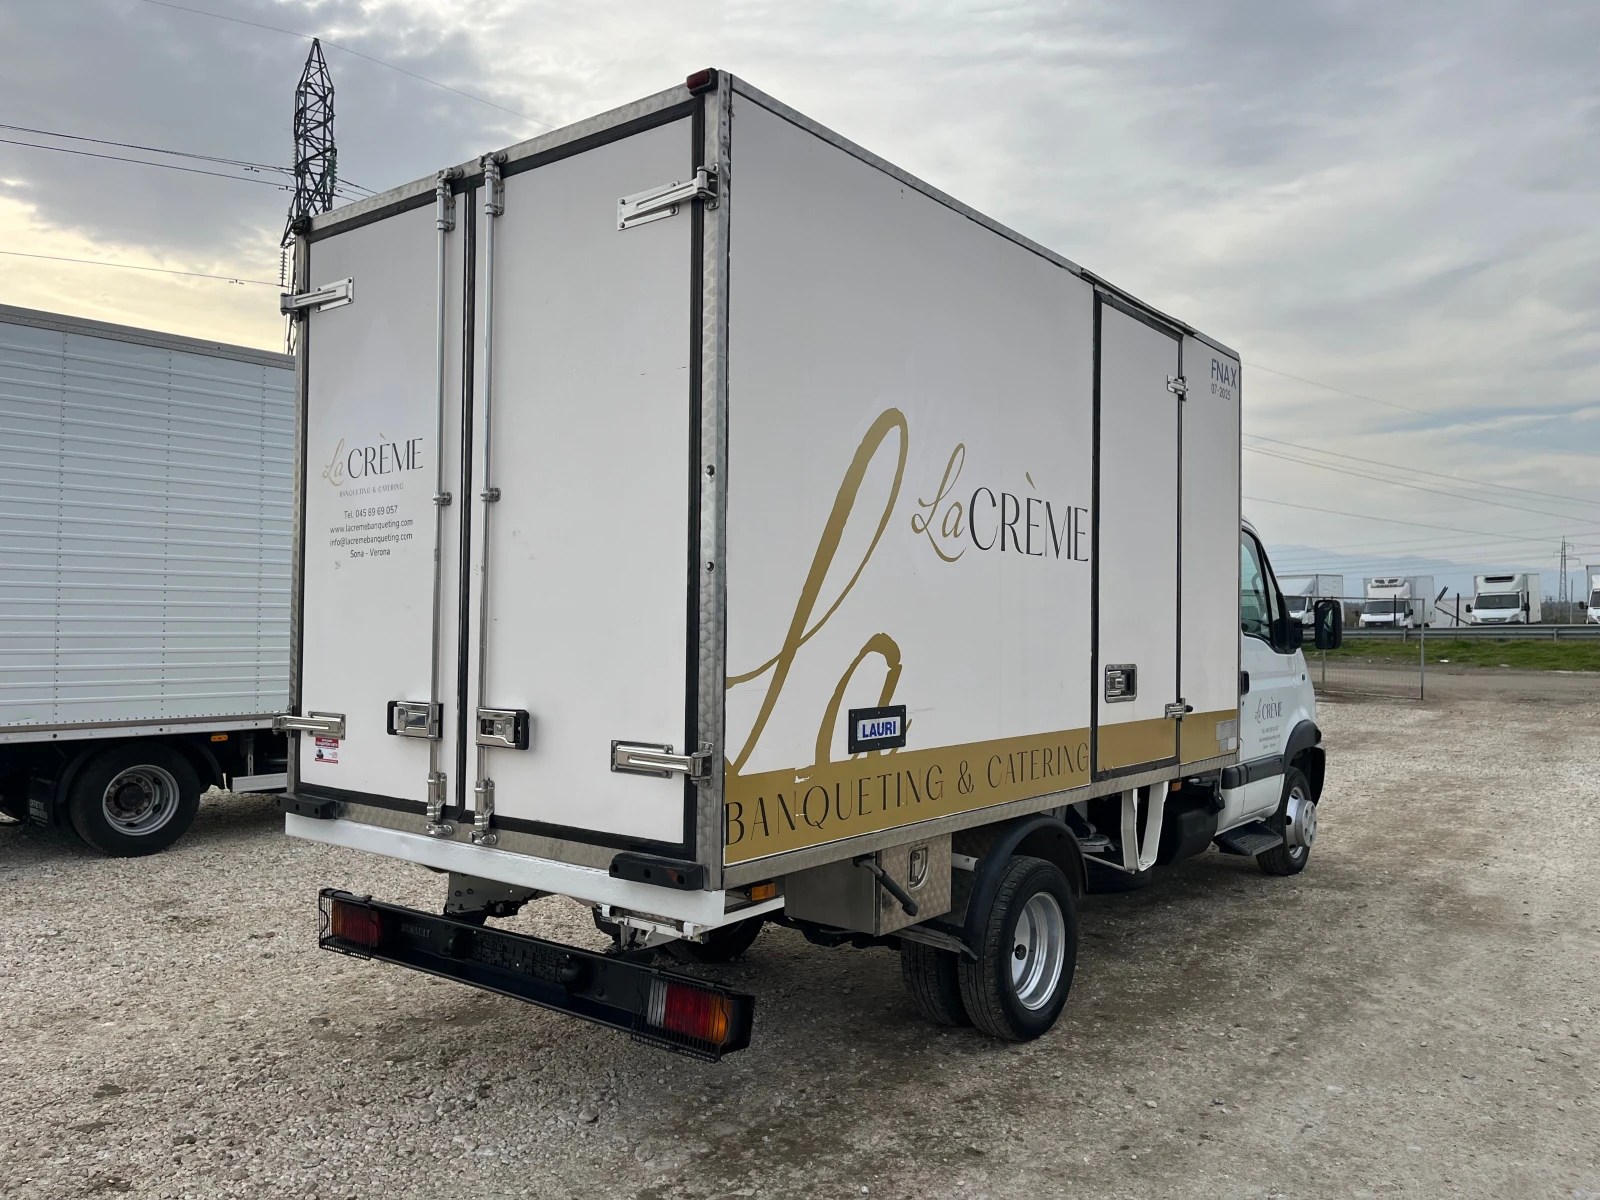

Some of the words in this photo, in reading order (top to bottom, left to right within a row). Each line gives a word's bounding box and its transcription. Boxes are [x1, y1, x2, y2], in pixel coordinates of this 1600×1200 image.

[1211, 358, 1237, 389] FNAX
[355, 508, 367, 518] 045
[368, 507, 376, 517] 89
[386, 504, 398, 514] 057
[968, 471, 1089, 561] CRÈME
[329, 519, 414, 533] www.lacremebanqueting.com
[329, 533, 413, 547] info@lacremebanqueting.com
[350, 549, 365, 558] Sona
[369, 548, 391, 557] Verona
[862, 720, 897, 738] LAURI
[725, 764, 944, 846] BANQUETING
[957, 759, 975, 795] &
[986, 742, 1090, 789] CATERING
